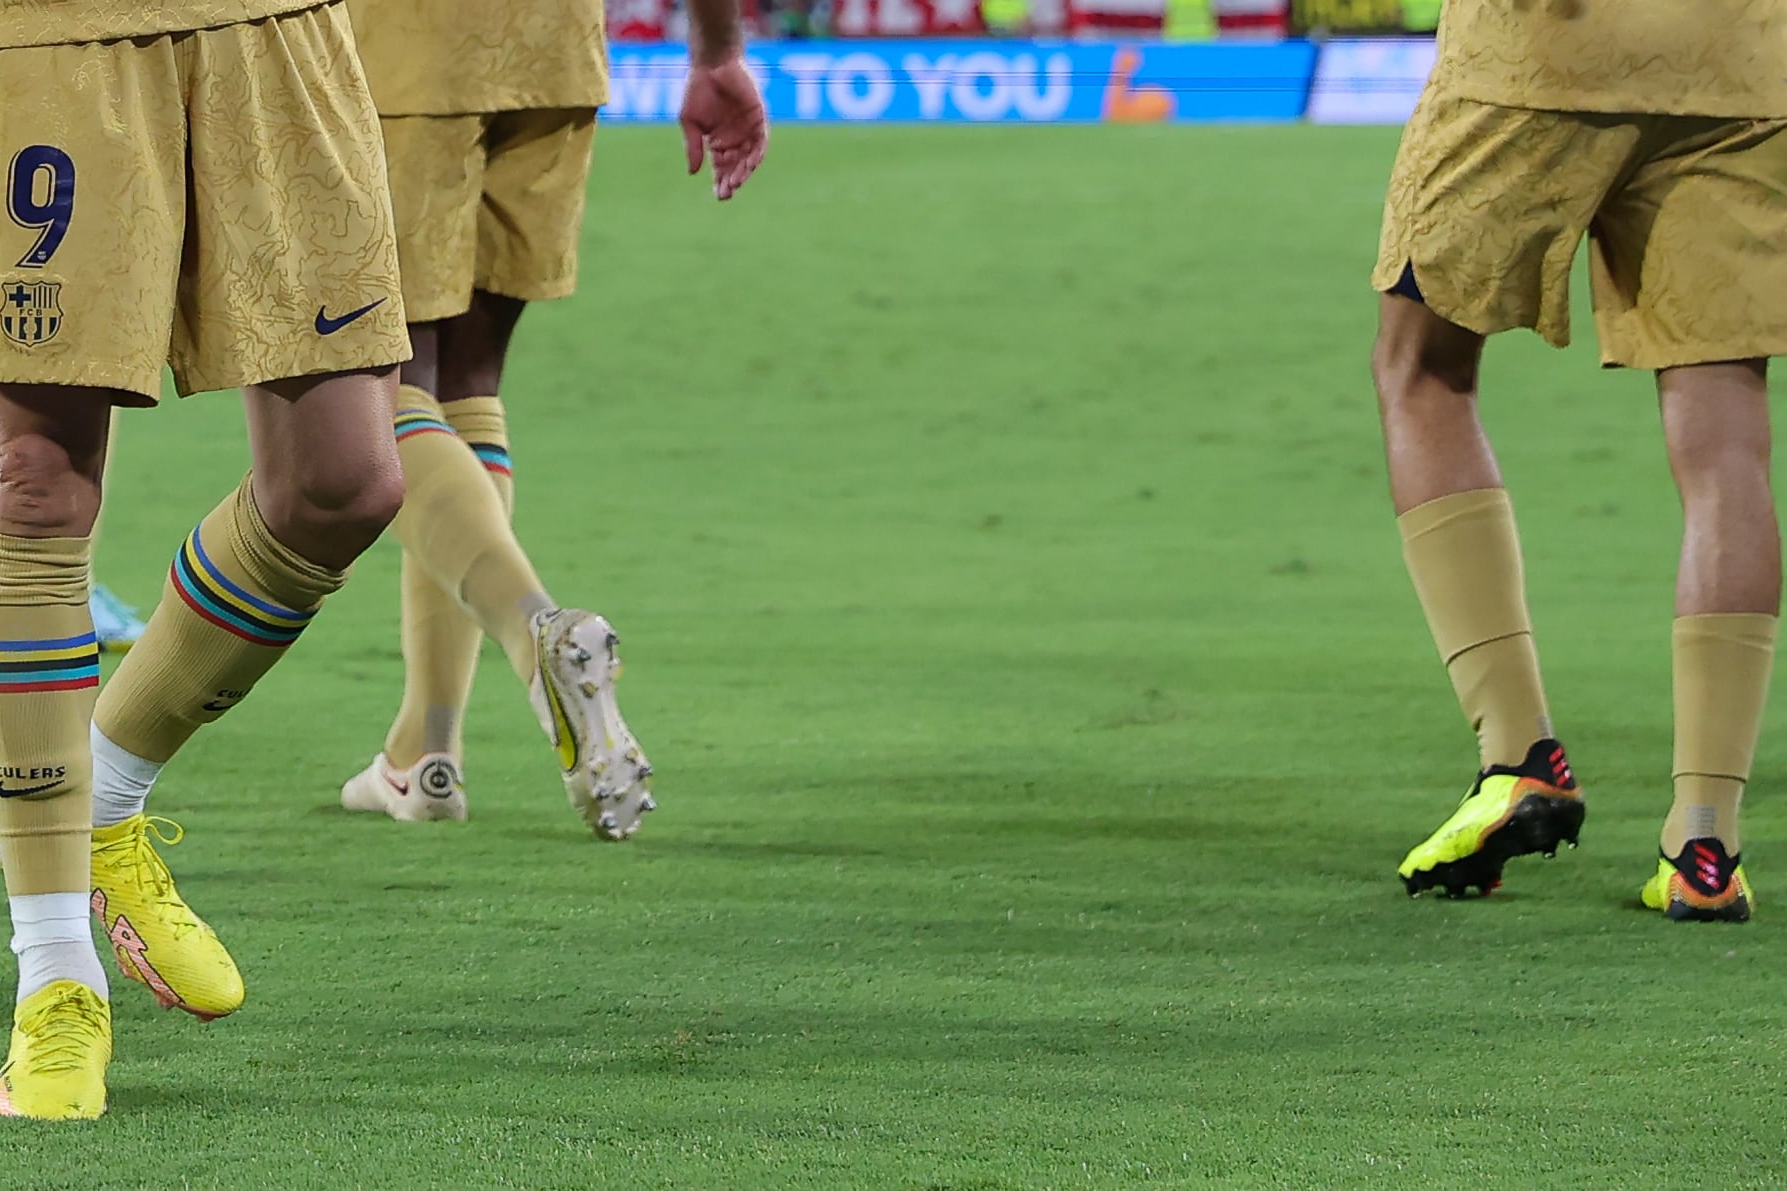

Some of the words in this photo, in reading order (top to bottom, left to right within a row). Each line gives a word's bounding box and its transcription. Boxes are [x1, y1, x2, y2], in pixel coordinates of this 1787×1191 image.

[779, 51, 896, 121] TO
[904, 51, 1074, 121] YOU
[6, 144, 76, 269] 9
